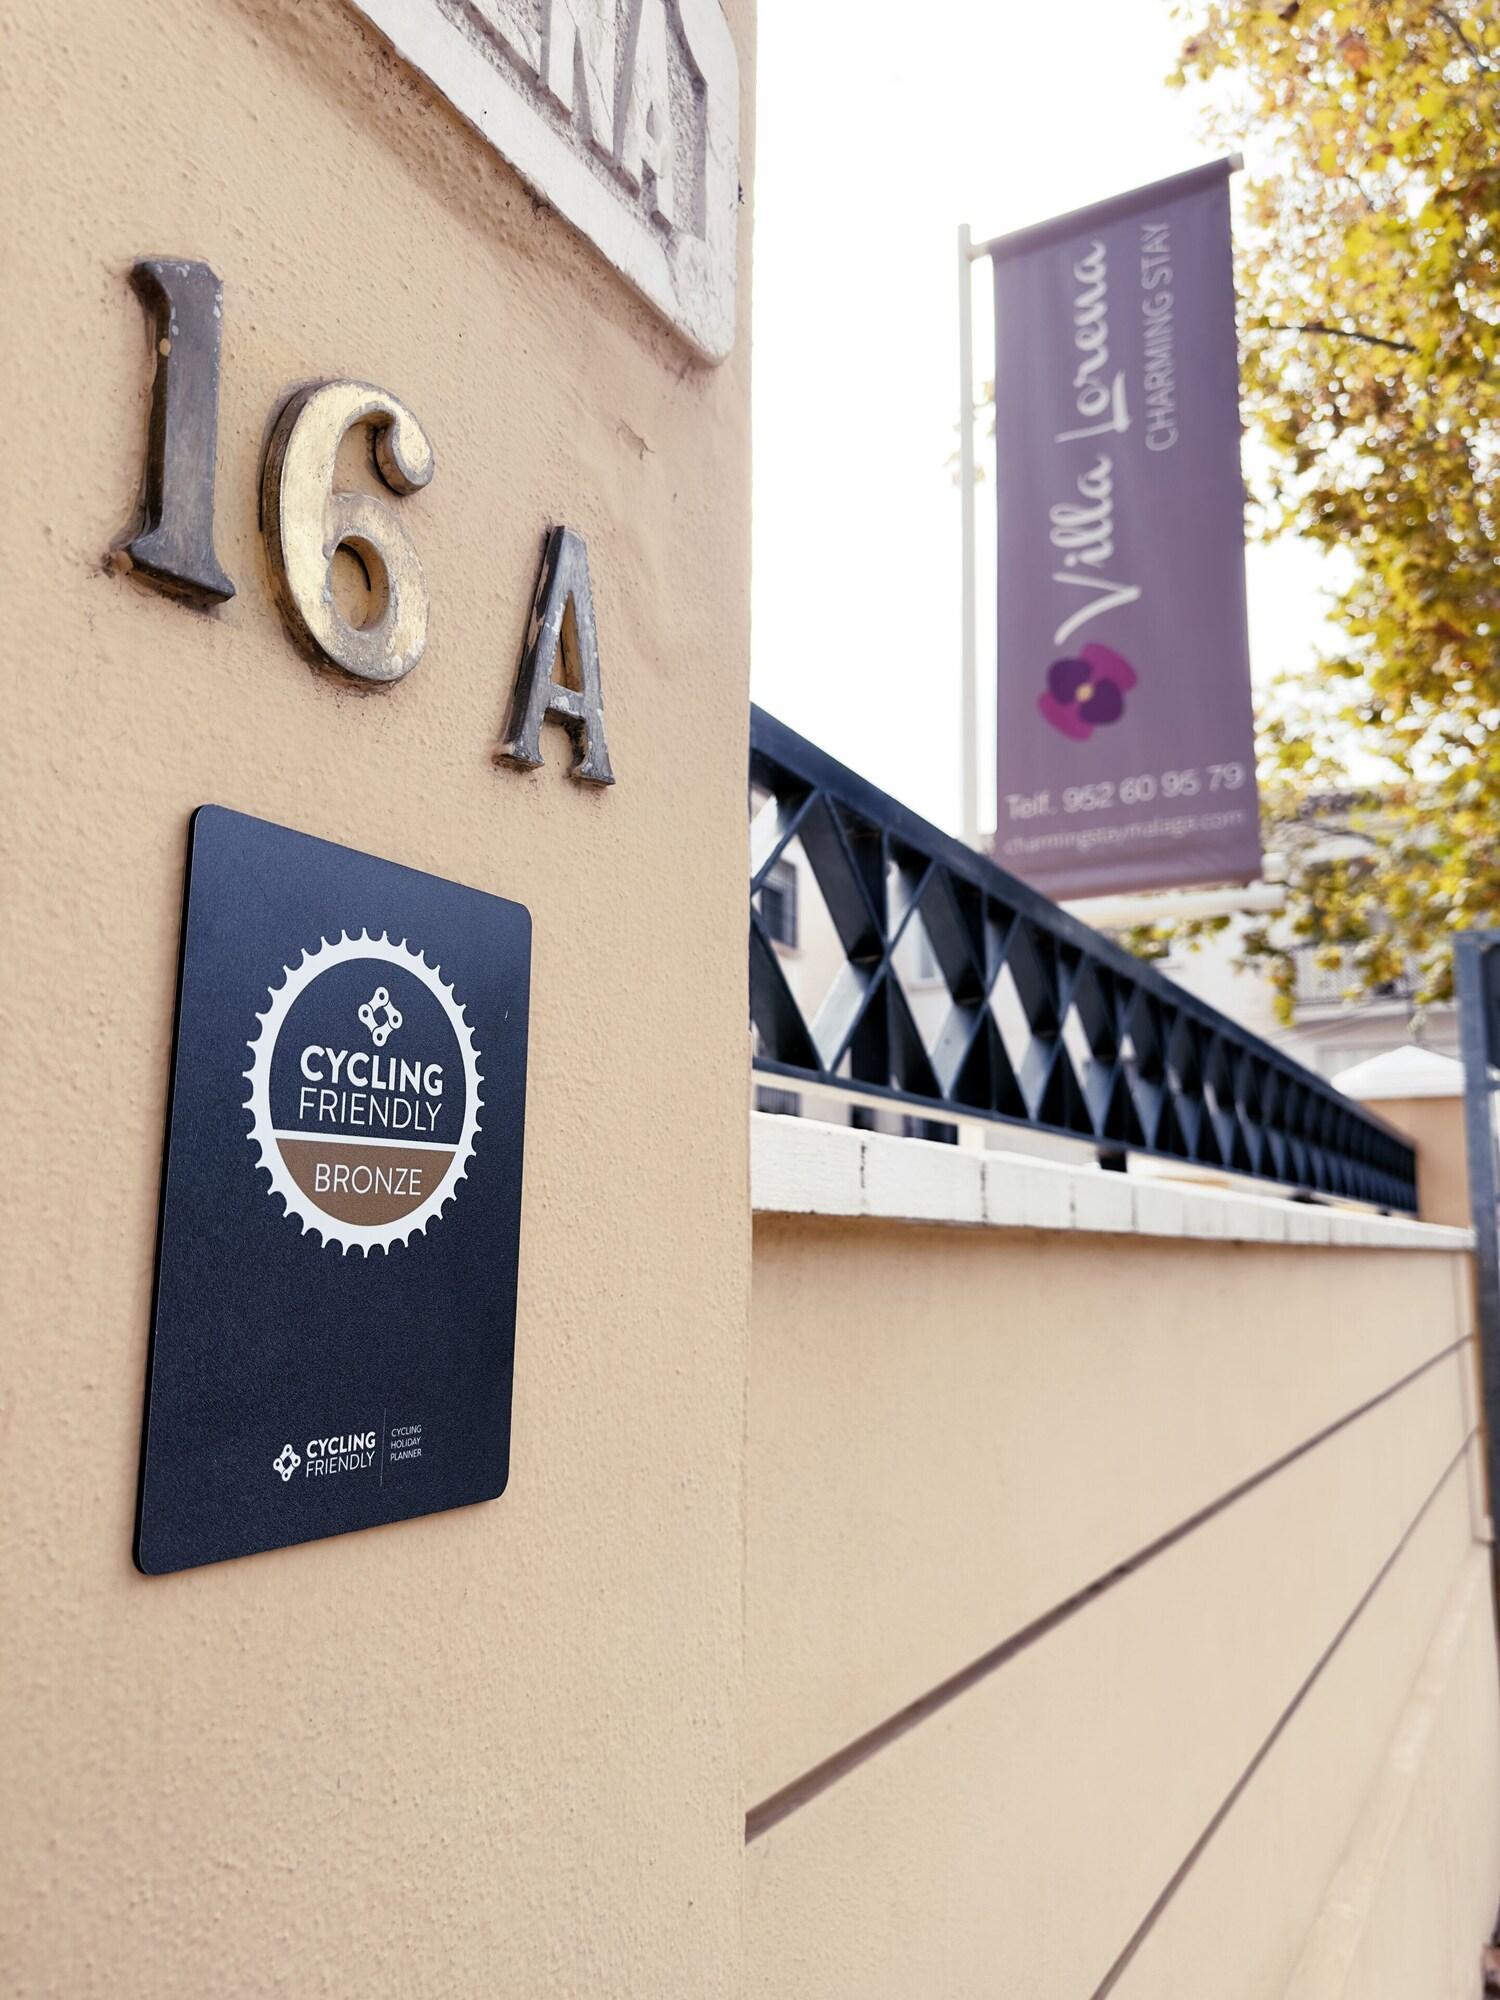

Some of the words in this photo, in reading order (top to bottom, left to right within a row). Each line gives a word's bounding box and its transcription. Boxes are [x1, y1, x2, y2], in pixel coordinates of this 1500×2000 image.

[1140, 222, 1174, 291] STAY
[1054, 239, 1131, 443] Lorena
[1141, 291, 1178, 452] CHARMING
[1049, 453, 1141, 647] Villa
[496, 525, 615, 786] A
[1062, 780, 1115, 813] 952
[1119, 773, 1158, 804] 60
[1206, 761, 1247, 791] 79
[300, 1045, 444, 1096] CYCLING
[299, 1087, 442, 1131] FRIENDLY
[315, 1163, 423, 1196] BRONZE
[306, 1431, 376, 1458] CYCLING
[390, 1437, 421, 1449] HOLIDAY
[390, 1448, 422, 1461] PLANNER
[391, 1425, 422, 1437] CYCLING
[306, 1451, 375, 1478] FRIENDLY
